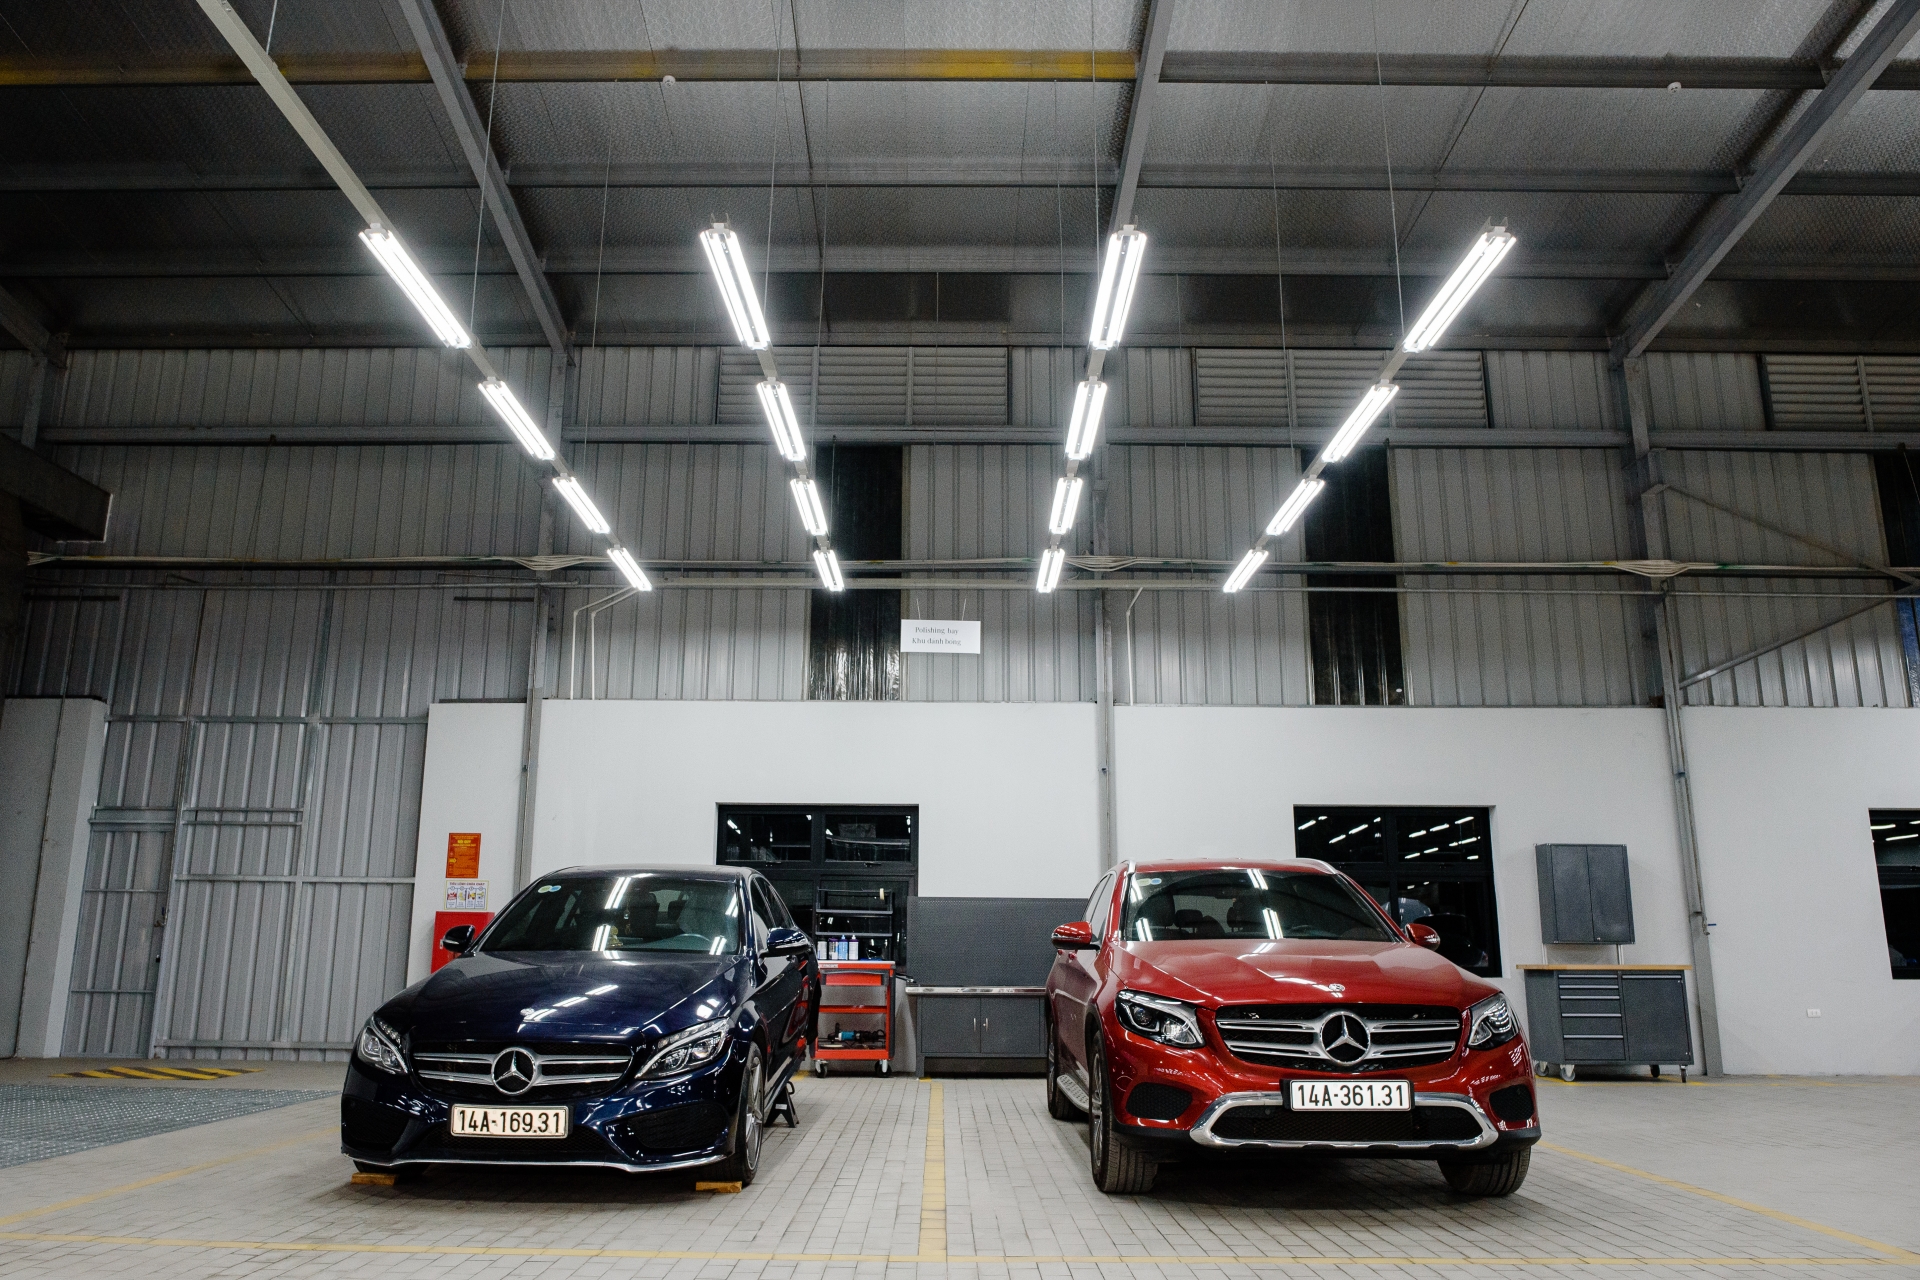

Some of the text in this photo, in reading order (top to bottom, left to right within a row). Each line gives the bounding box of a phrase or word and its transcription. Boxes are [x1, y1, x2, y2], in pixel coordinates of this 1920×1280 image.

[915, 627, 959, 636] Polishing bay
[1298, 1084, 1403, 1107] 14A-361.31
[459, 1109, 560, 1133] 14A-169.31
